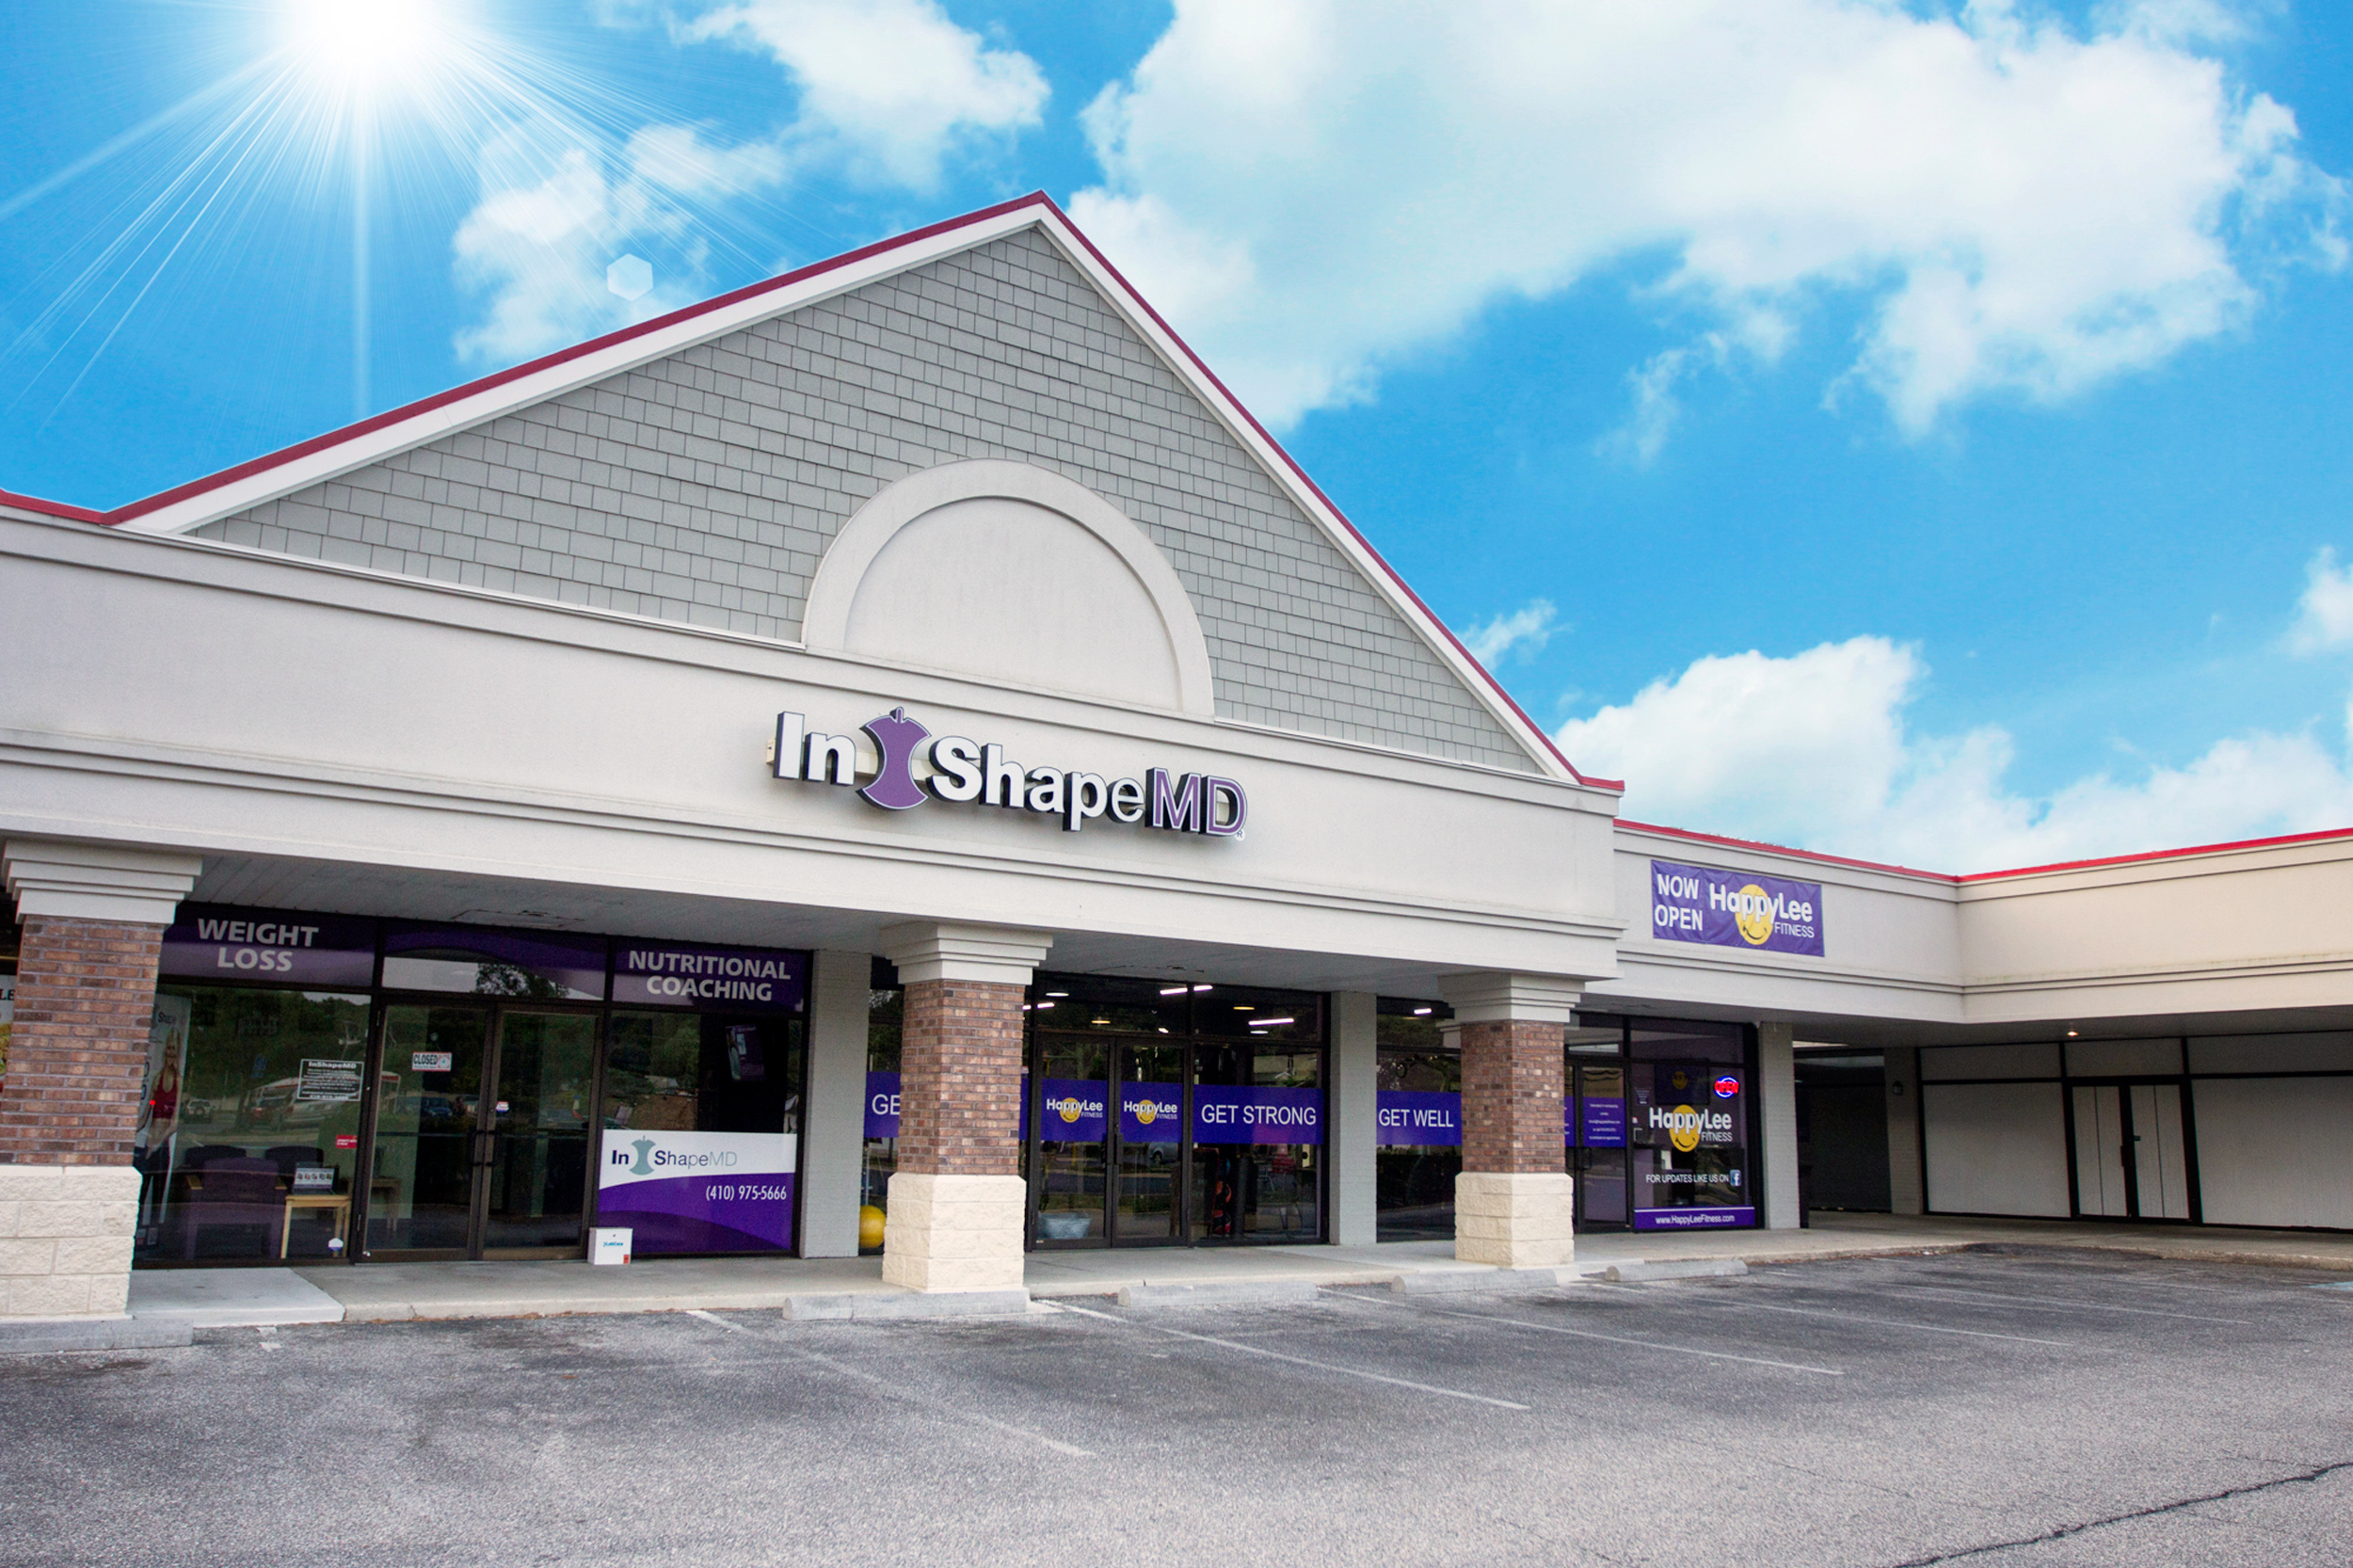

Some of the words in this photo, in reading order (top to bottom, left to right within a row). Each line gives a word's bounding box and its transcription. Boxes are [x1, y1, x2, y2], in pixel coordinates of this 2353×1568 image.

[773, 711, 856, 785] In
[927, 735, 1248, 836] ShapeMD
[1657, 873, 1700, 900] NOW
[1709, 883, 1813, 924] HappyLee
[1655, 904, 1704, 931] OPEN
[198, 918, 320, 948] WEIGHT
[1774, 921, 1815, 938] FITNESS
[217, 946, 293, 972] LOSS
[628, 950, 792, 981] NUTRITIONAL
[646, 975, 773, 1002] COACHING
[413, 1054, 439, 1065] CLOSED
[1714, 1080, 1739, 1094] OPEN
[1046, 1097, 1103, 1114] HappyLee
[1080, 1111, 1103, 1119] FITNESS
[1123, 1100, 1178, 1115] HappyLee
[1201, 1104, 1239, 1124] GET
[1242, 1105, 1317, 1126] STRONG
[1378, 1108, 1411, 1127] GET
[1413, 1109, 1454, 1128] WELL
[1648, 1106, 1733, 1136] HappyLee
[1701, 1131, 1733, 1143] FITNESS
[611, 1149, 630, 1165] In
[653, 1149, 738, 1170] ShapeMD
[1645, 1174, 1661, 1183] FOR
[1661, 1174, 1692, 1183] UPDATES
[1693, 1174, 1708, 1183] LIKE
[1708, 1174, 1719, 1183] US
[1719, 1174, 1729, 1183] ON
[705, 1185, 735, 1201] (410)
[738, 1185, 787, 1201] 975-5666
[1655, 1213, 1736, 1225] www.HappyLeeFitness.com
